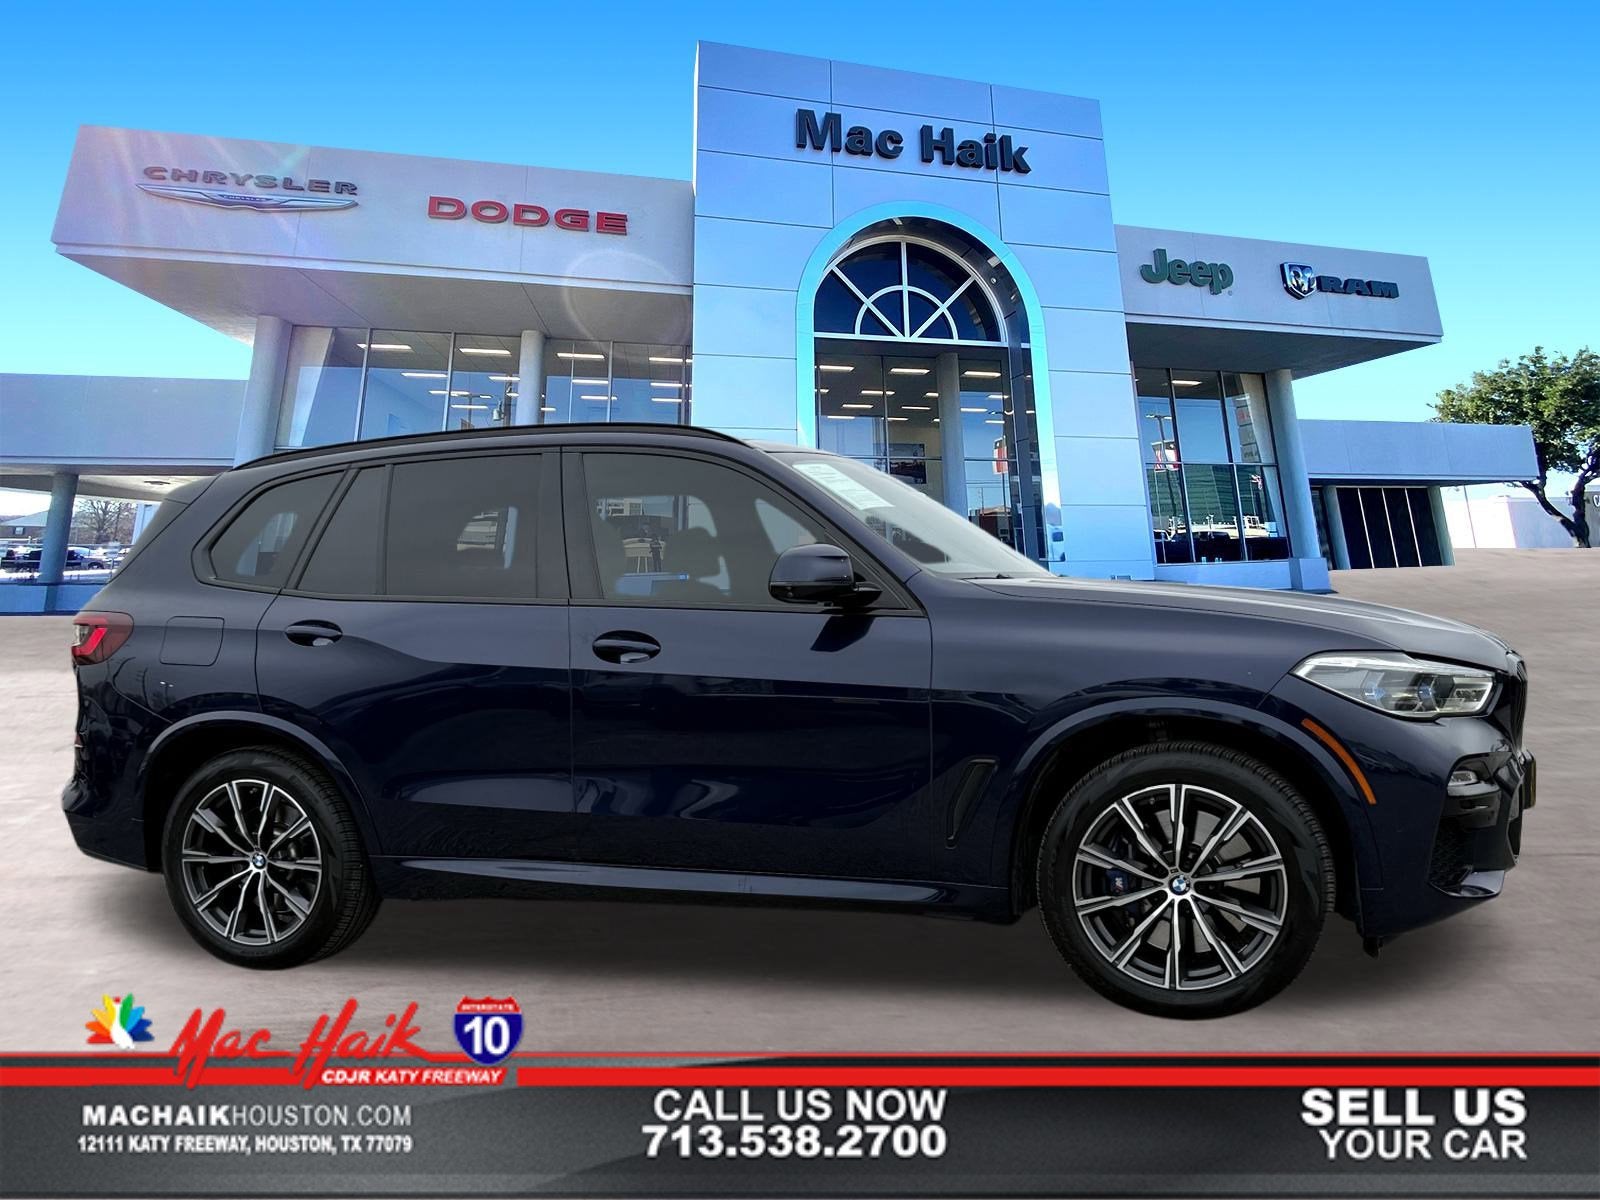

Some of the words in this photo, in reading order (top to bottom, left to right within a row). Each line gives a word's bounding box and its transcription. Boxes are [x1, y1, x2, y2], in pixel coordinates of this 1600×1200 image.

[796, 108, 904, 159] Mac
[920, 124, 1032, 174] Haik
[143, 166, 359, 196] CHRYSLER
[428, 196, 628, 235] DODGE
[1140, 248, 1234, 295] Jeep
[1316, 275, 1400, 299] RAM
